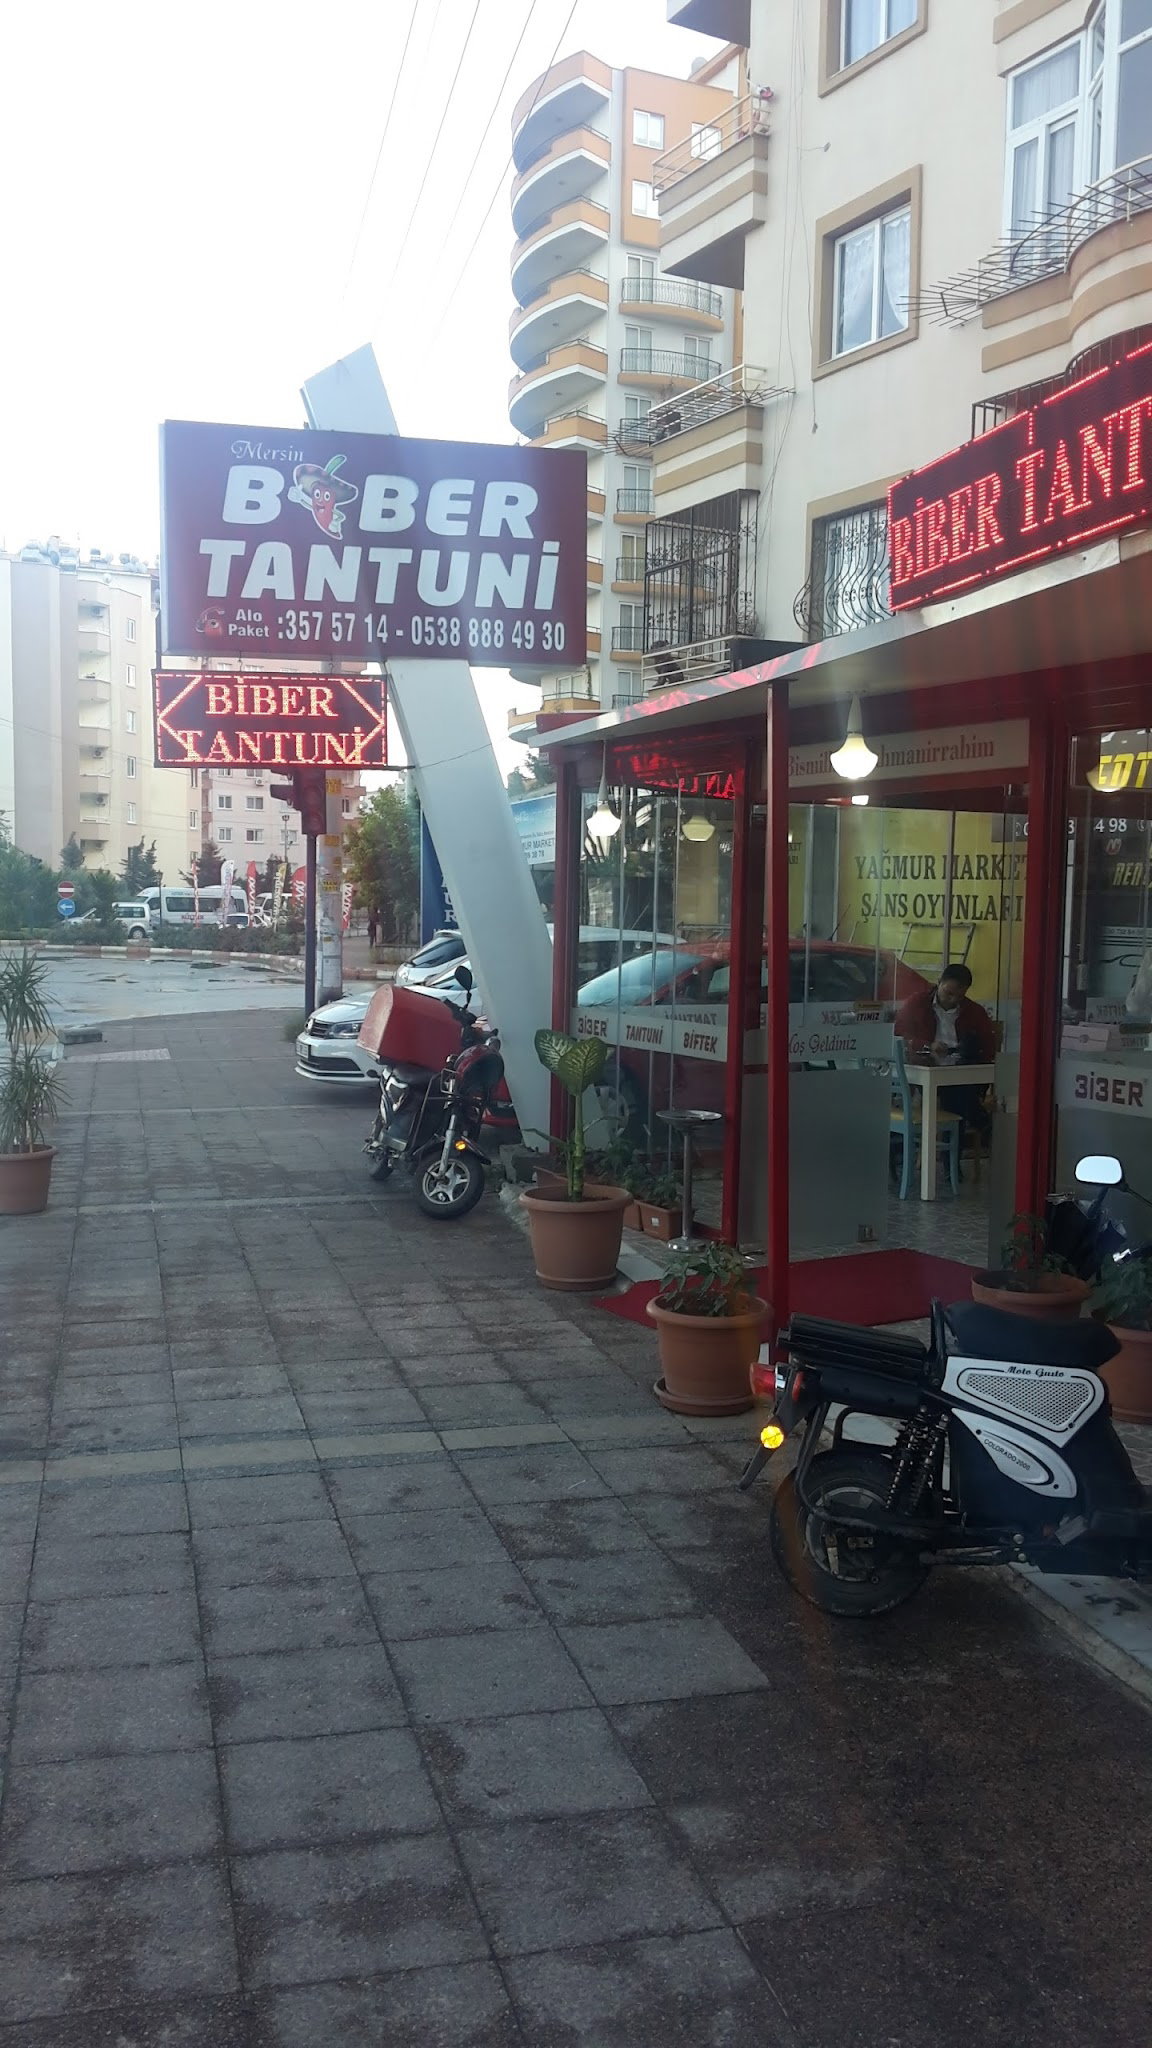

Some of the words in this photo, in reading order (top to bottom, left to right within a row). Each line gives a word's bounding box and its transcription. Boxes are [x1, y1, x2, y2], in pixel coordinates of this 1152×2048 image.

[231, 440, 304, 461] Mersin
[892, 472, 1004, 587] BİBER
[236, 609, 262, 622] Alo
[228, 624, 269, 638] Paket
[331, 611, 355, 642] 57
[364, 613, 388, 643] 14
[411, 615, 460, 647] 0538
[468, 617, 504, 648] 888
[511, 620, 535, 650] 49
[542, 621, 565, 651] 30
[205, 677, 338, 717] BİBER
[177, 725, 366, 766] TANTUNİ
[855, 849, 936, 880] YAĞMUR
[861, 893, 908, 924] ŞANS
[808, 1033, 857, 1054] Geldiniz
[1005, 1366, 1031, 1375] Moto
[984, 1439, 1017, 1461] COLORADO
